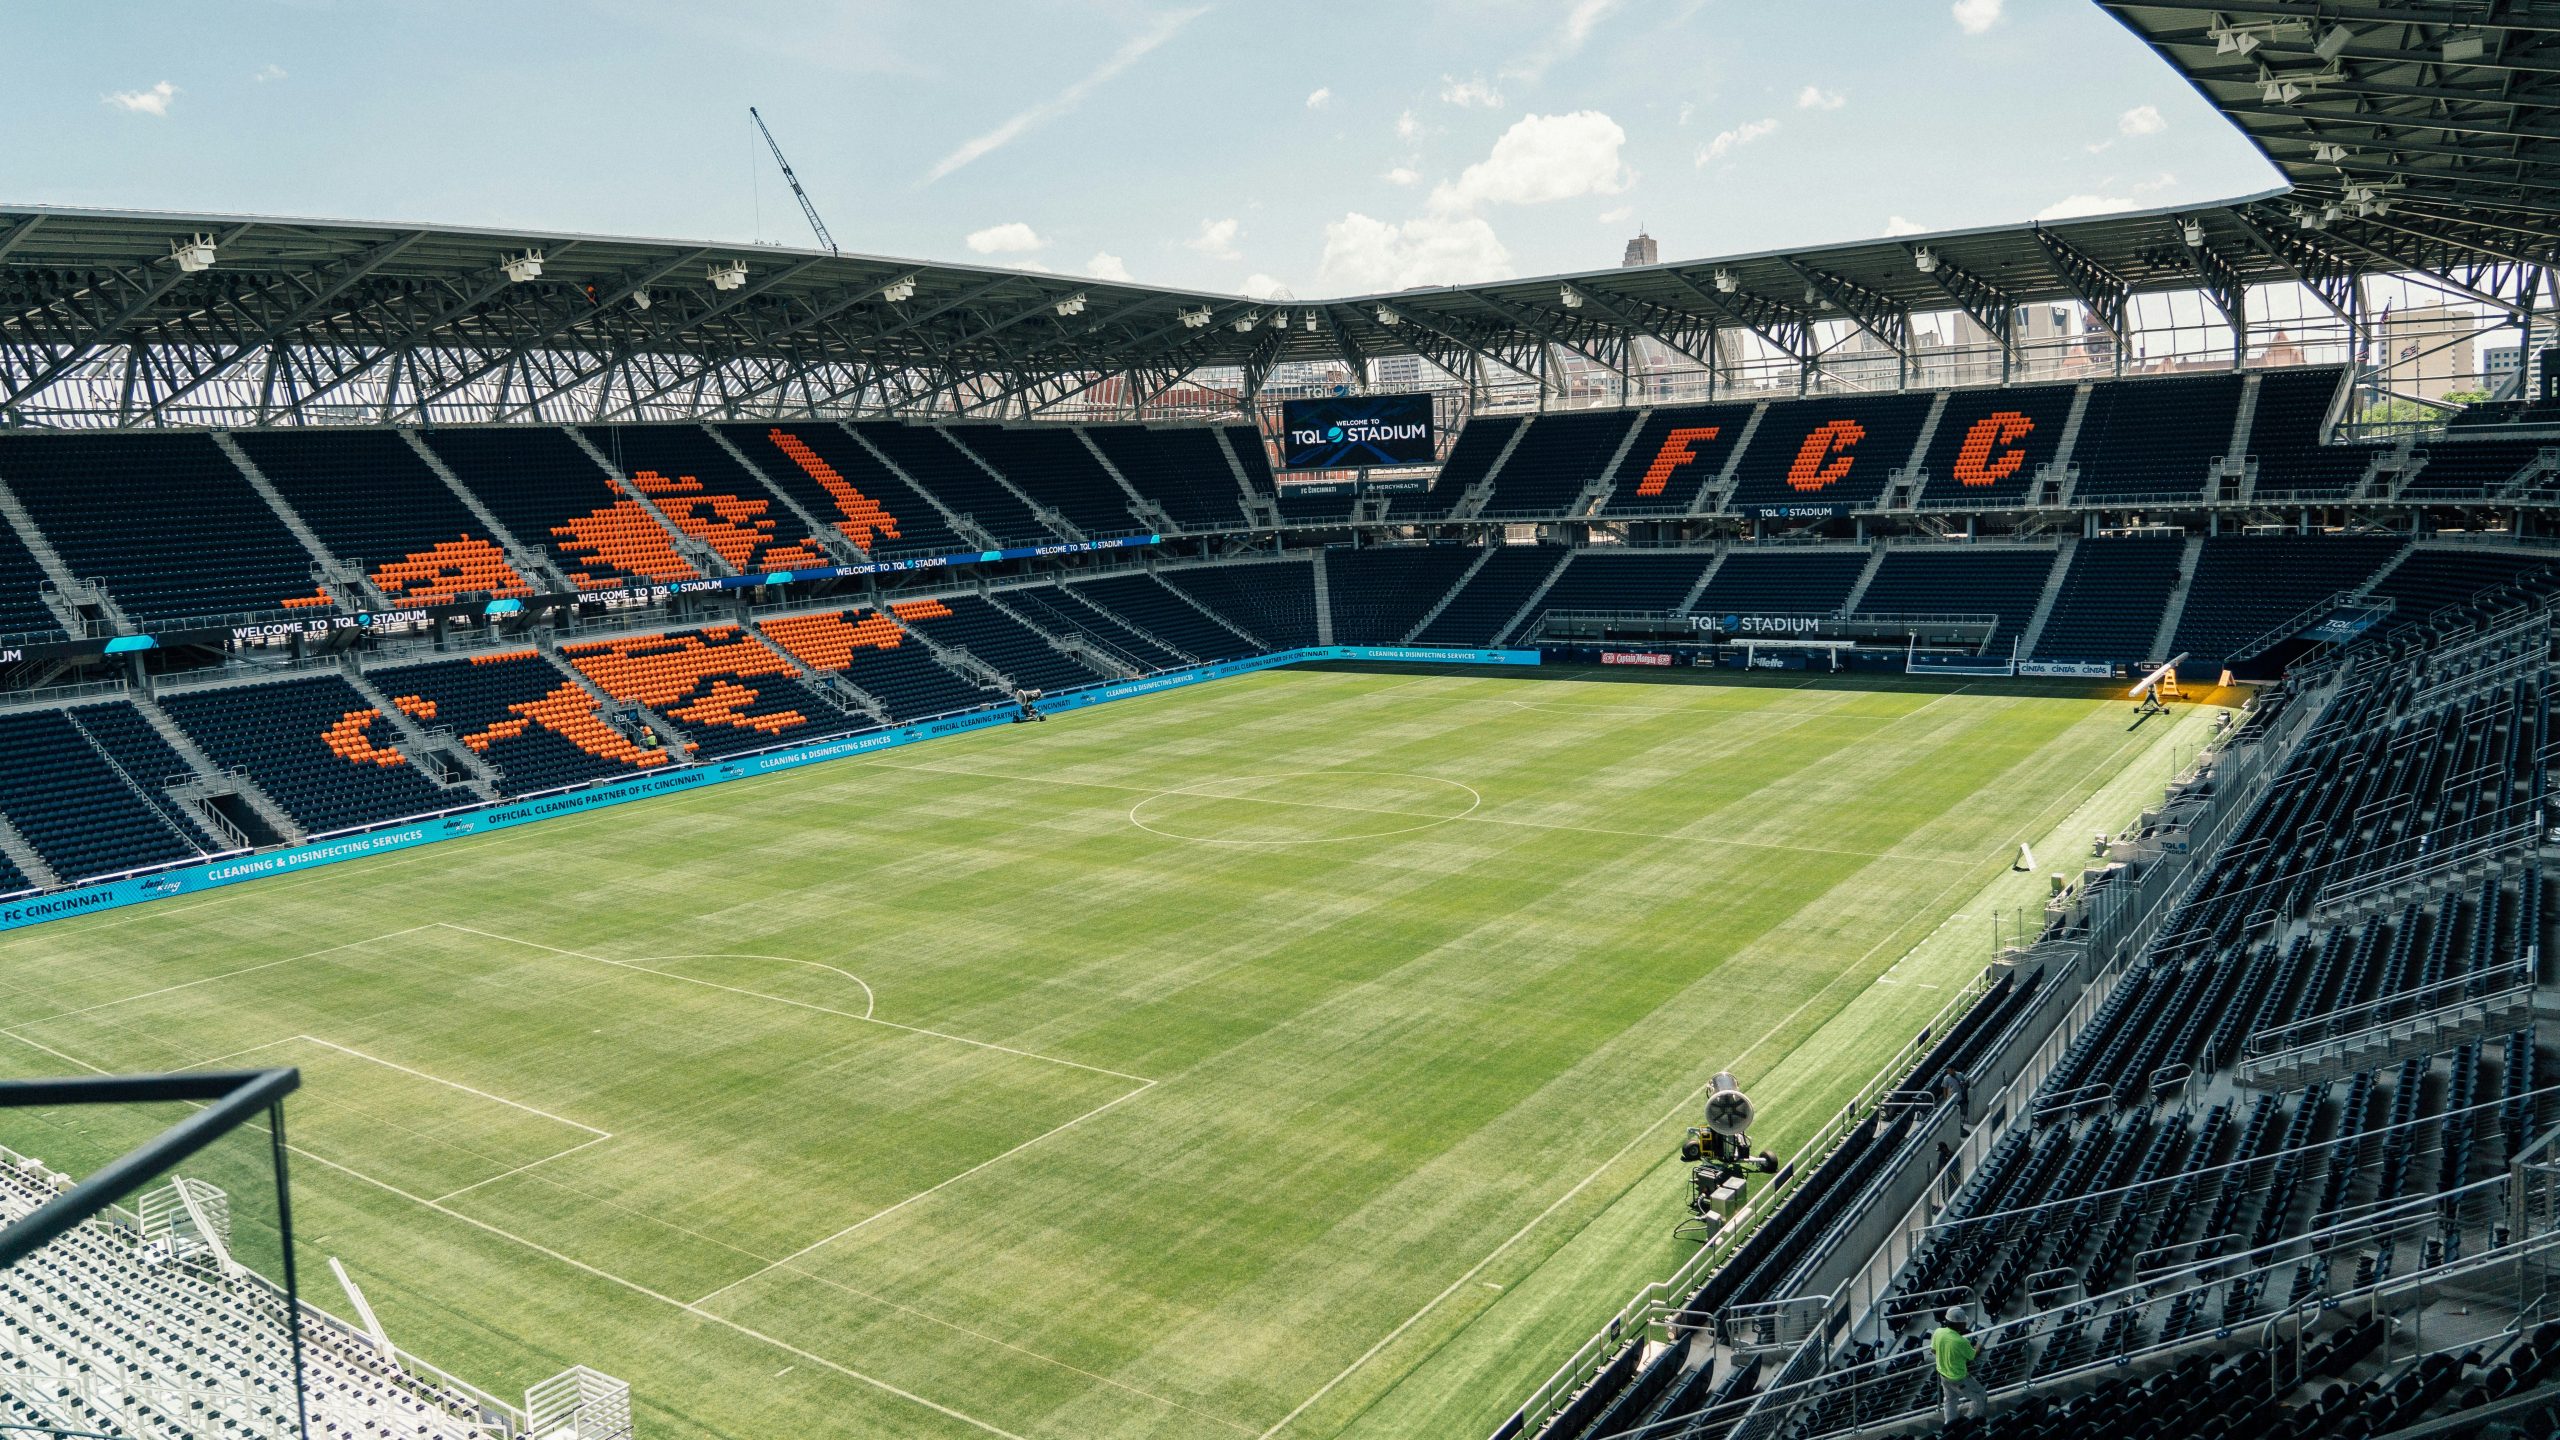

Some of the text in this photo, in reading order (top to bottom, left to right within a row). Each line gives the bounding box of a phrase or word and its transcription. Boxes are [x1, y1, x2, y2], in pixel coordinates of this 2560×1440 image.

[1336, 419, 1368, 427] WELCOME
[1292, 424, 1426, 445] TQL STADIUM
[1760, 507, 1832, 517] TQL STADIUM
[1035, 538, 1123, 556] WELCOME TO TQL STADIUM
[835, 556, 947, 577] WELCOME TO TQL STADIUM
[577, 580, 722, 604] WELCOME TO TQL STADIUM
[232, 609, 427, 640] WELCOME TO TQL STADIUM
[1688, 616, 1819, 632] TQL STADIUM
[1368, 650, 1398, 658] CLEANING
[1405, 651, 1446, 660] DISINFECTING
[1447, 652, 1476, 660] SERVICES
[1106, 686, 1132, 698] CLEANING
[1172, 673, 1194, 685] SERVICES
[931, 721, 960, 734] OFFICIAL
[960, 715, 992, 728] CLEANING
[760, 735, 891, 769] CLEANING & DISINFECTING SERVICES
[488, 773, 705, 824] OFFICIAL CLEANING PARTNER OF FC CINCINNATI
[208, 829, 423, 881] CLEANING & DISINFECTING SERVICES
[2161, 841, 2179, 850] TQL
[4, 891, 113, 923] FC CINCINNATI
